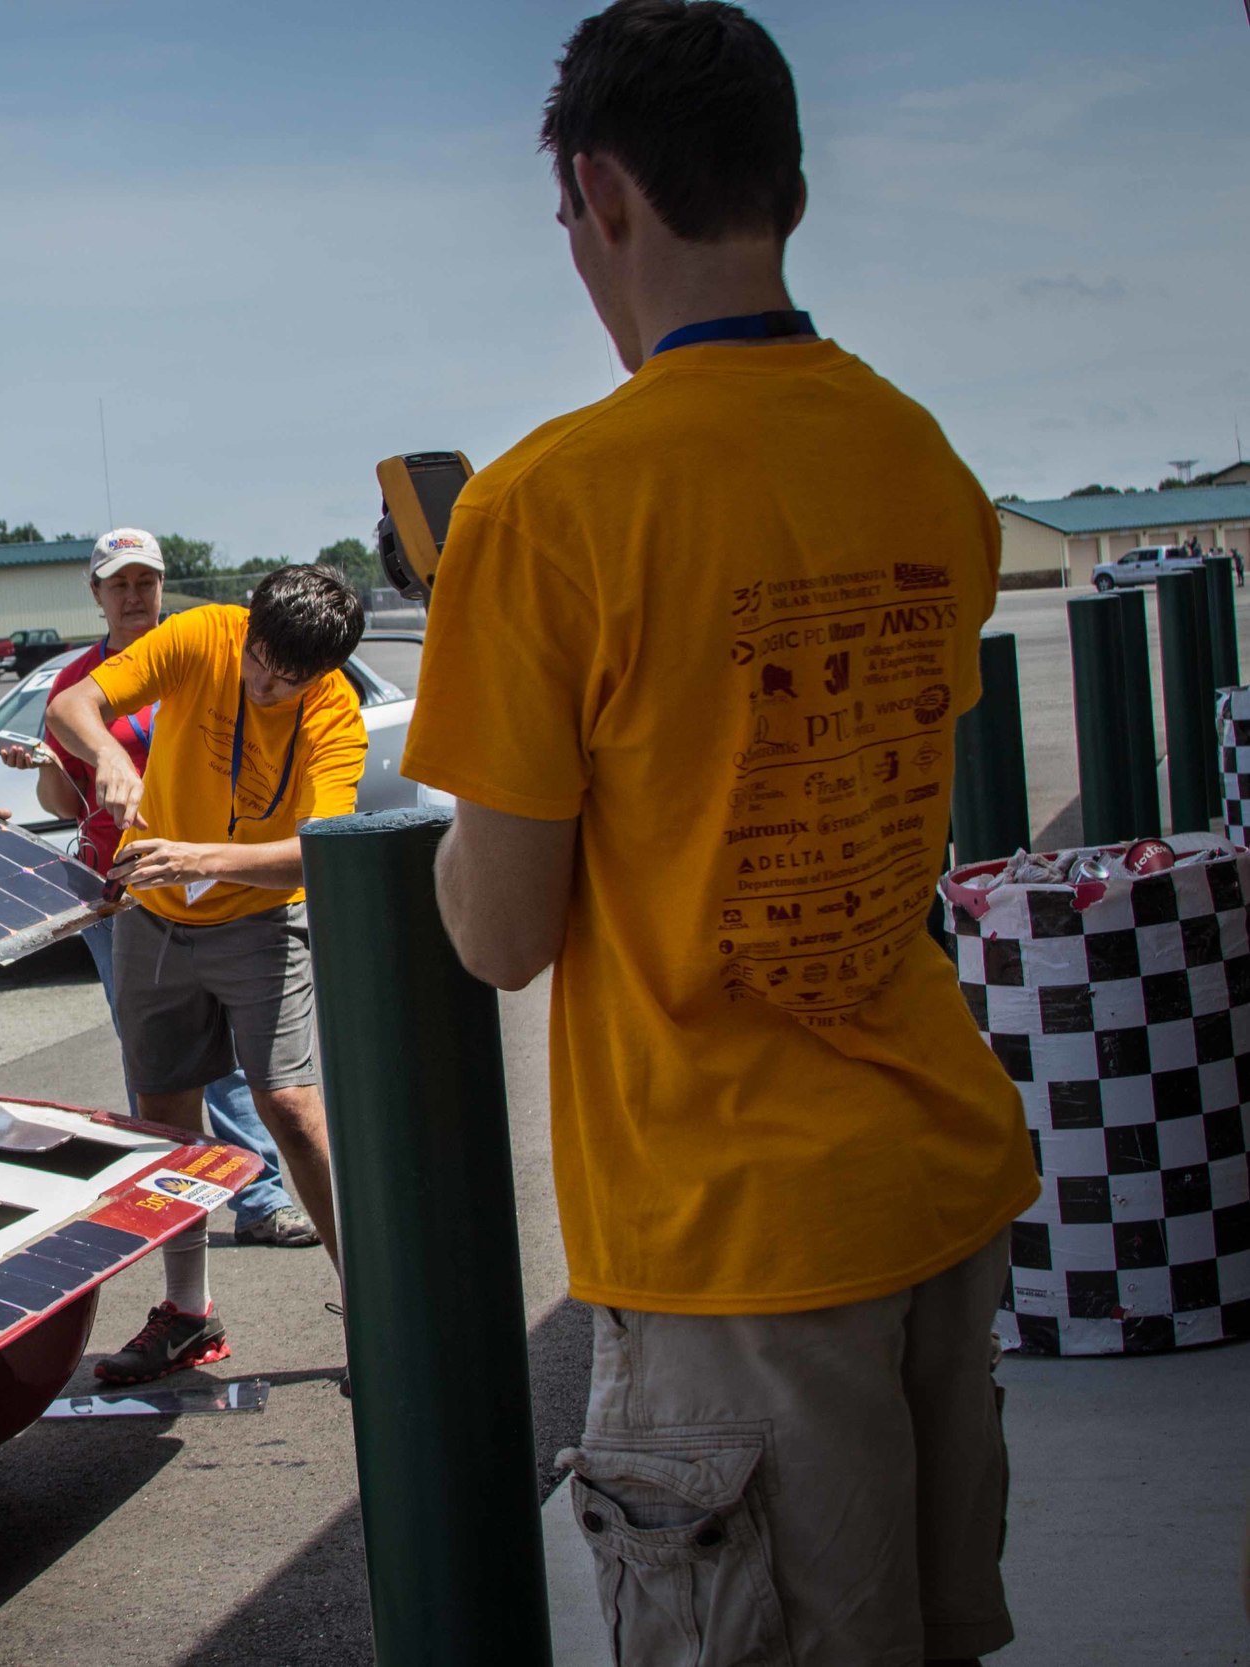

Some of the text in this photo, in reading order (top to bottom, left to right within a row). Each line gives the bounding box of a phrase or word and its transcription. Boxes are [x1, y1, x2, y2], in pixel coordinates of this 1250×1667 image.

[879, 603, 958, 638] ANSYS
[759, 849, 826, 871] DELTA
[136, 1193, 175, 1212] EOS
